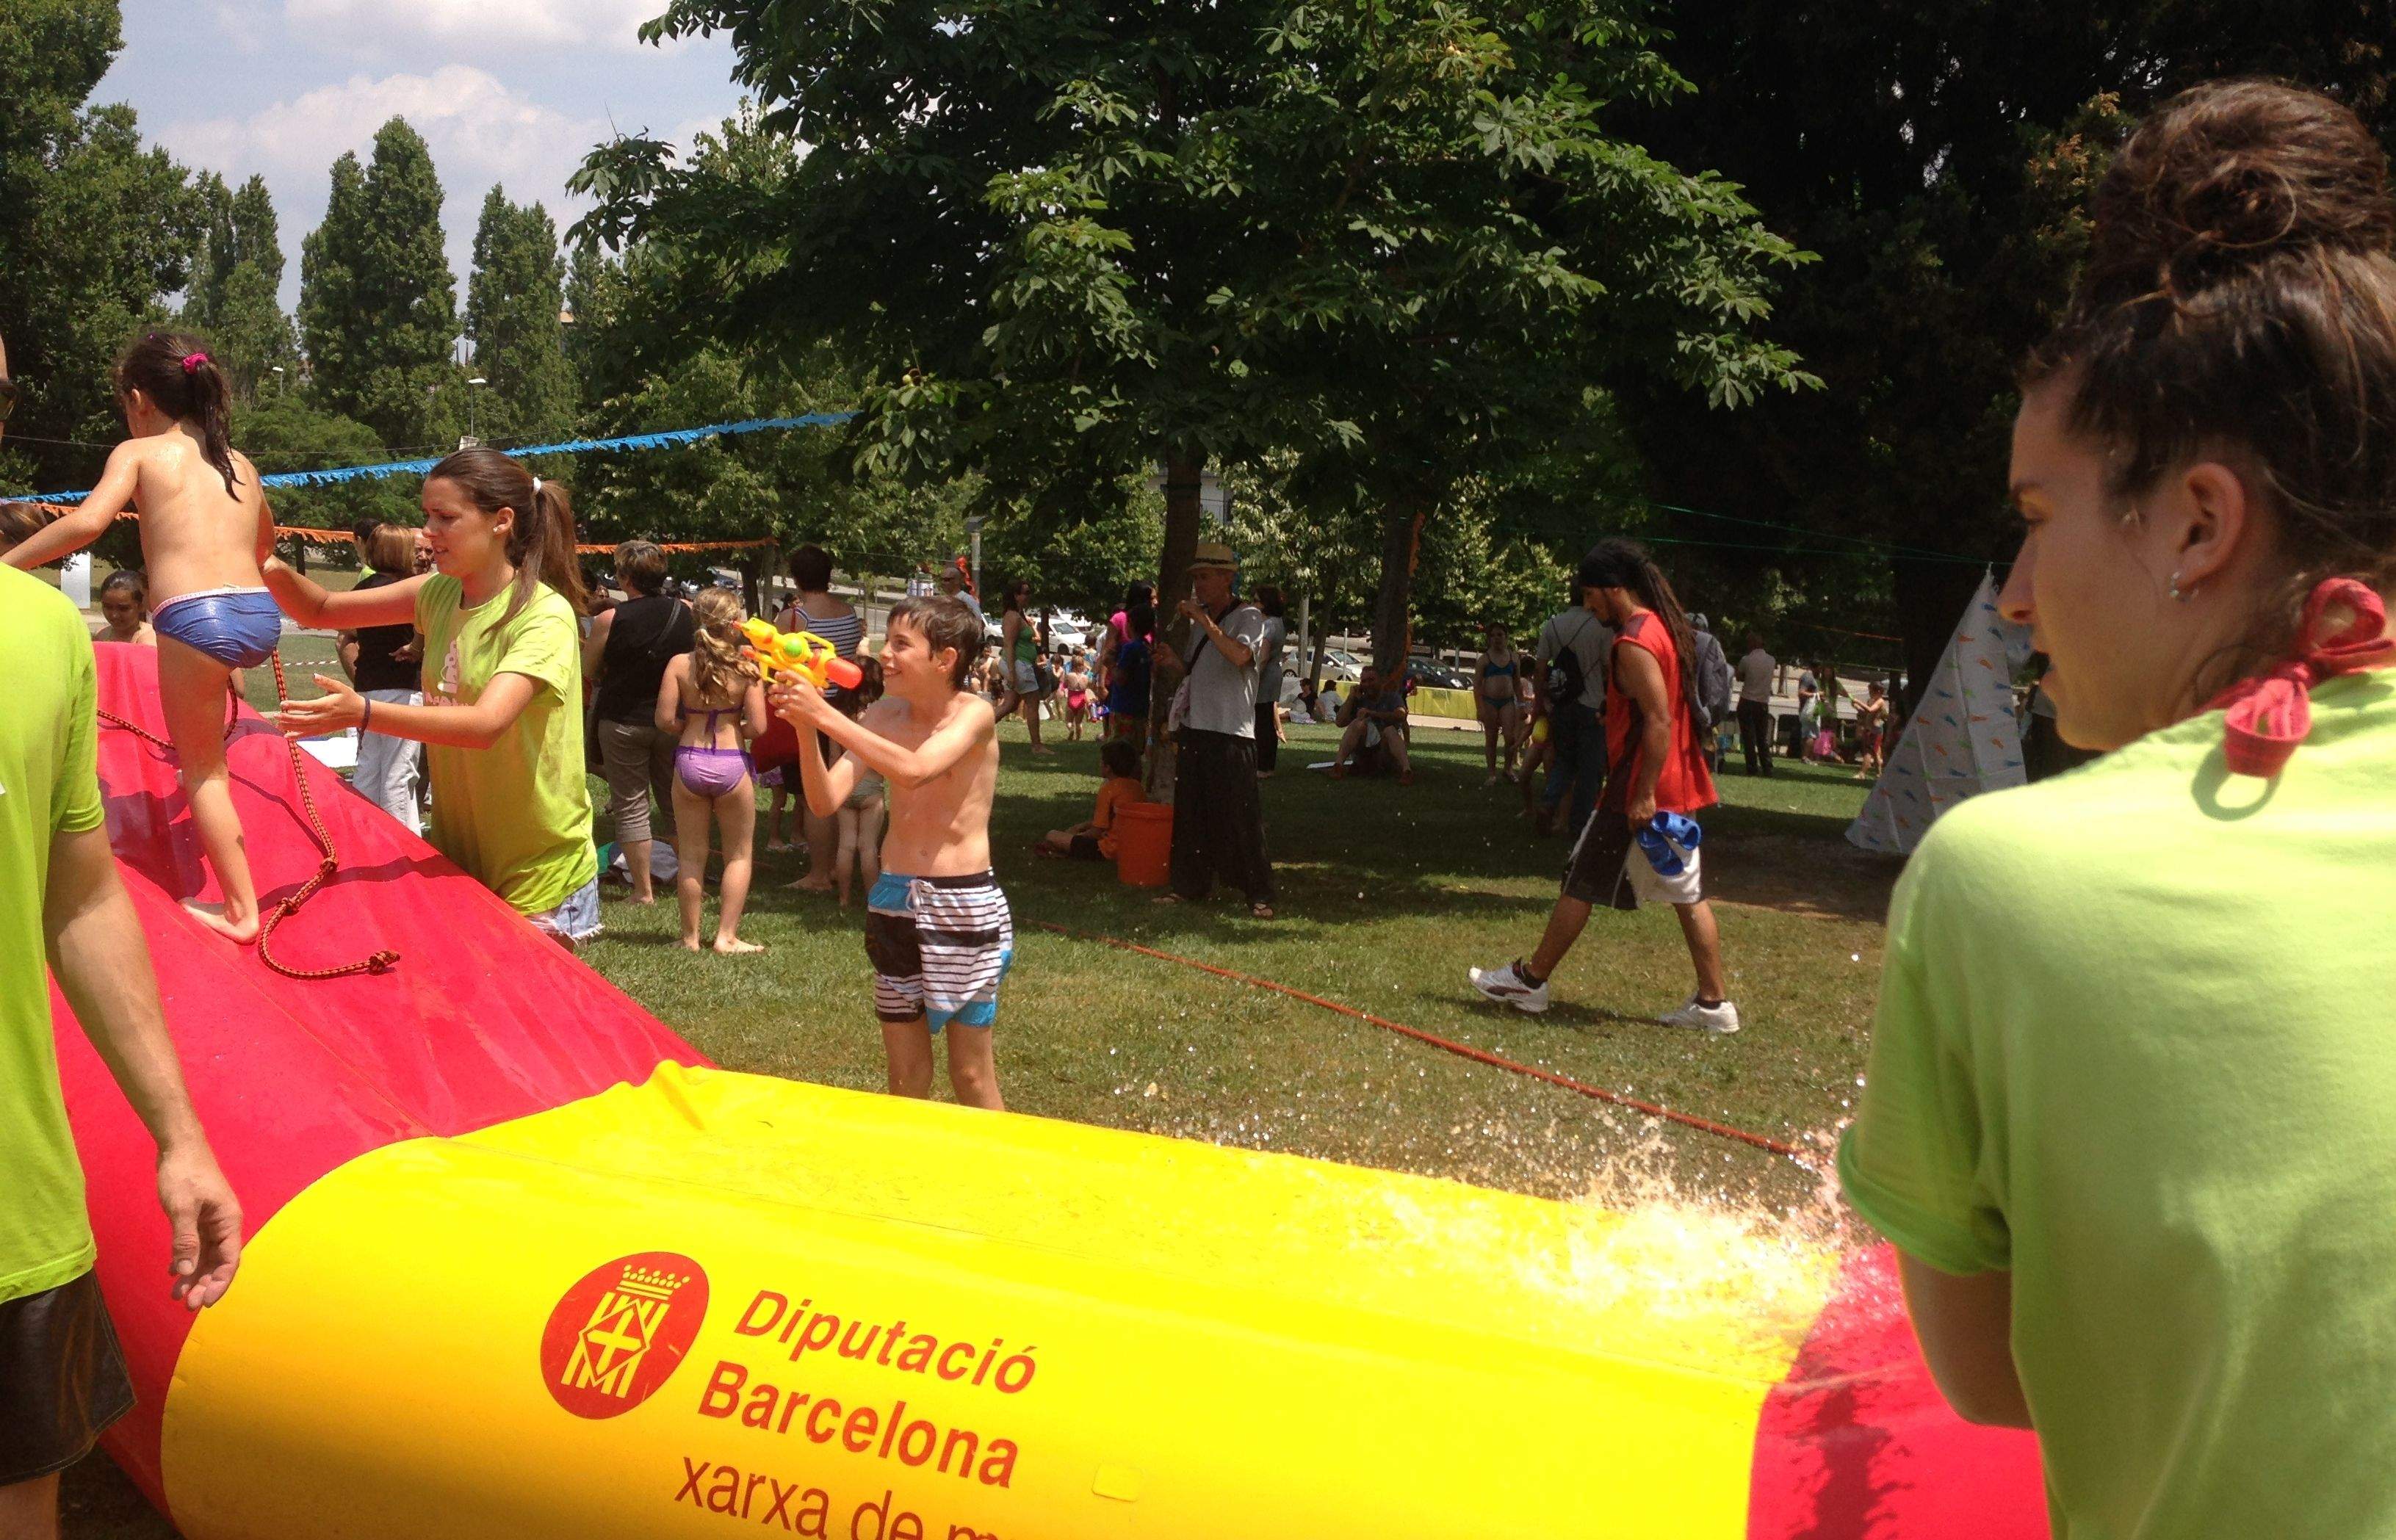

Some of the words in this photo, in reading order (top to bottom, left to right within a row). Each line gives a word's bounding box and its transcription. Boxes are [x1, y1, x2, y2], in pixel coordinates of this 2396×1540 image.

[734, 1290, 1037, 1393] Diputació
[697, 1360, 1019, 1489] Barcelona
[673, 1456, 831, 1540] xarxa
[849, 1489, 925, 1540] de
